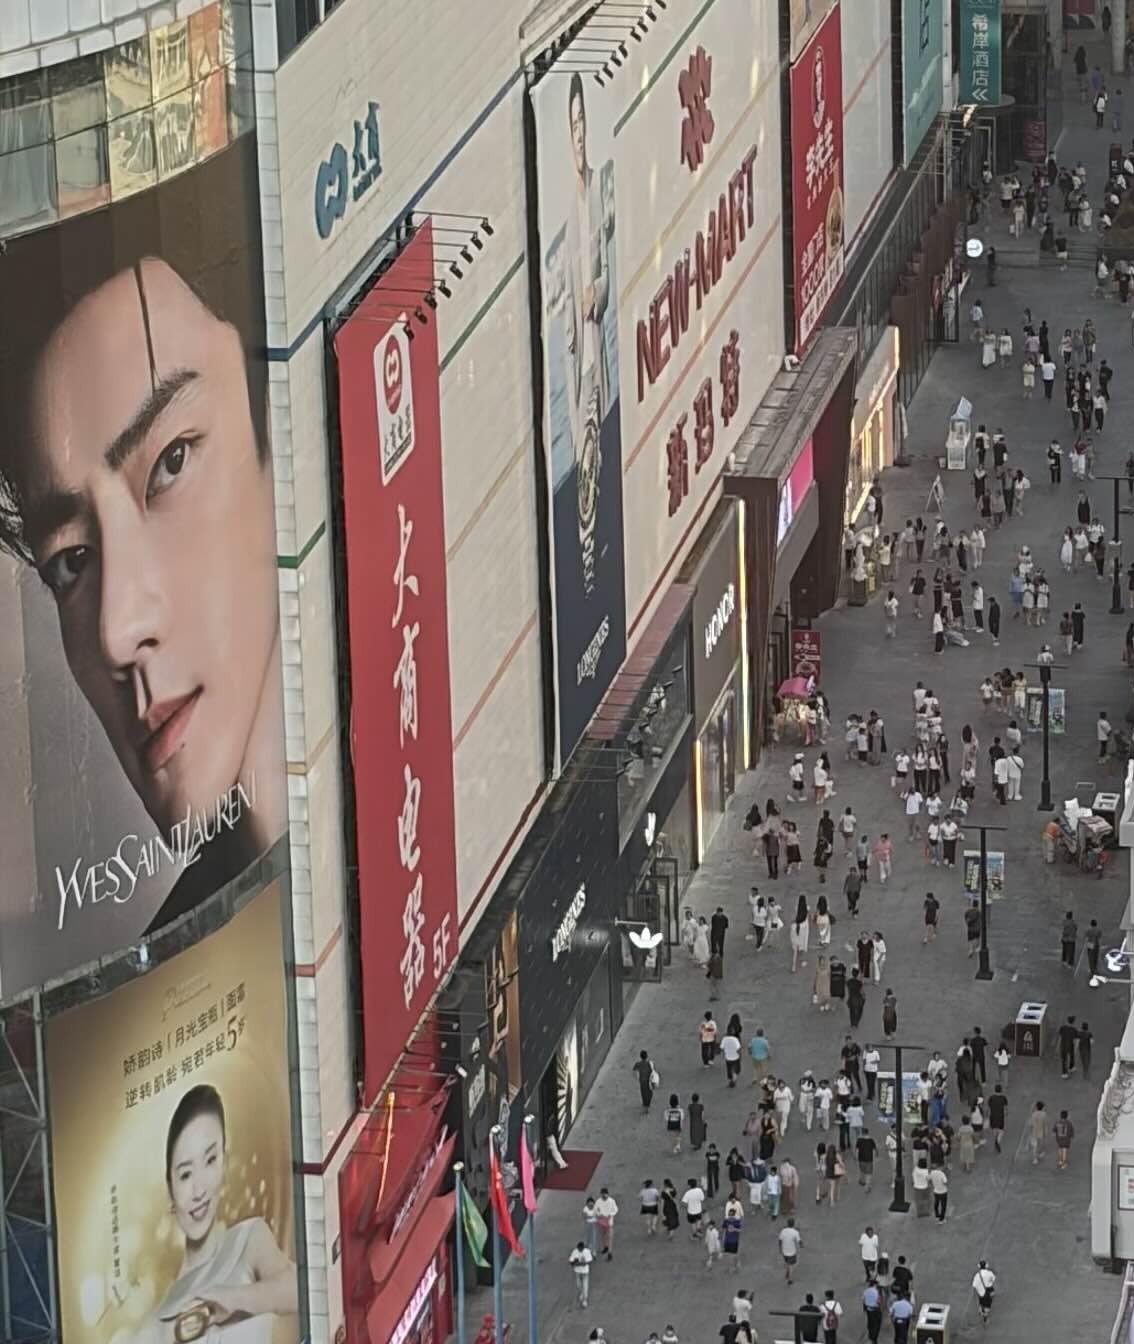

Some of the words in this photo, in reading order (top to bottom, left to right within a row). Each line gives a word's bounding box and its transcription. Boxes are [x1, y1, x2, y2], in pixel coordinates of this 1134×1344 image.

[635, 143, 759, 403] NEW-MART
[703, 581, 736, 659] HONOR
[390, 505, 427, 1012] 大商电器
[431, 911, 452, 981] 5F
